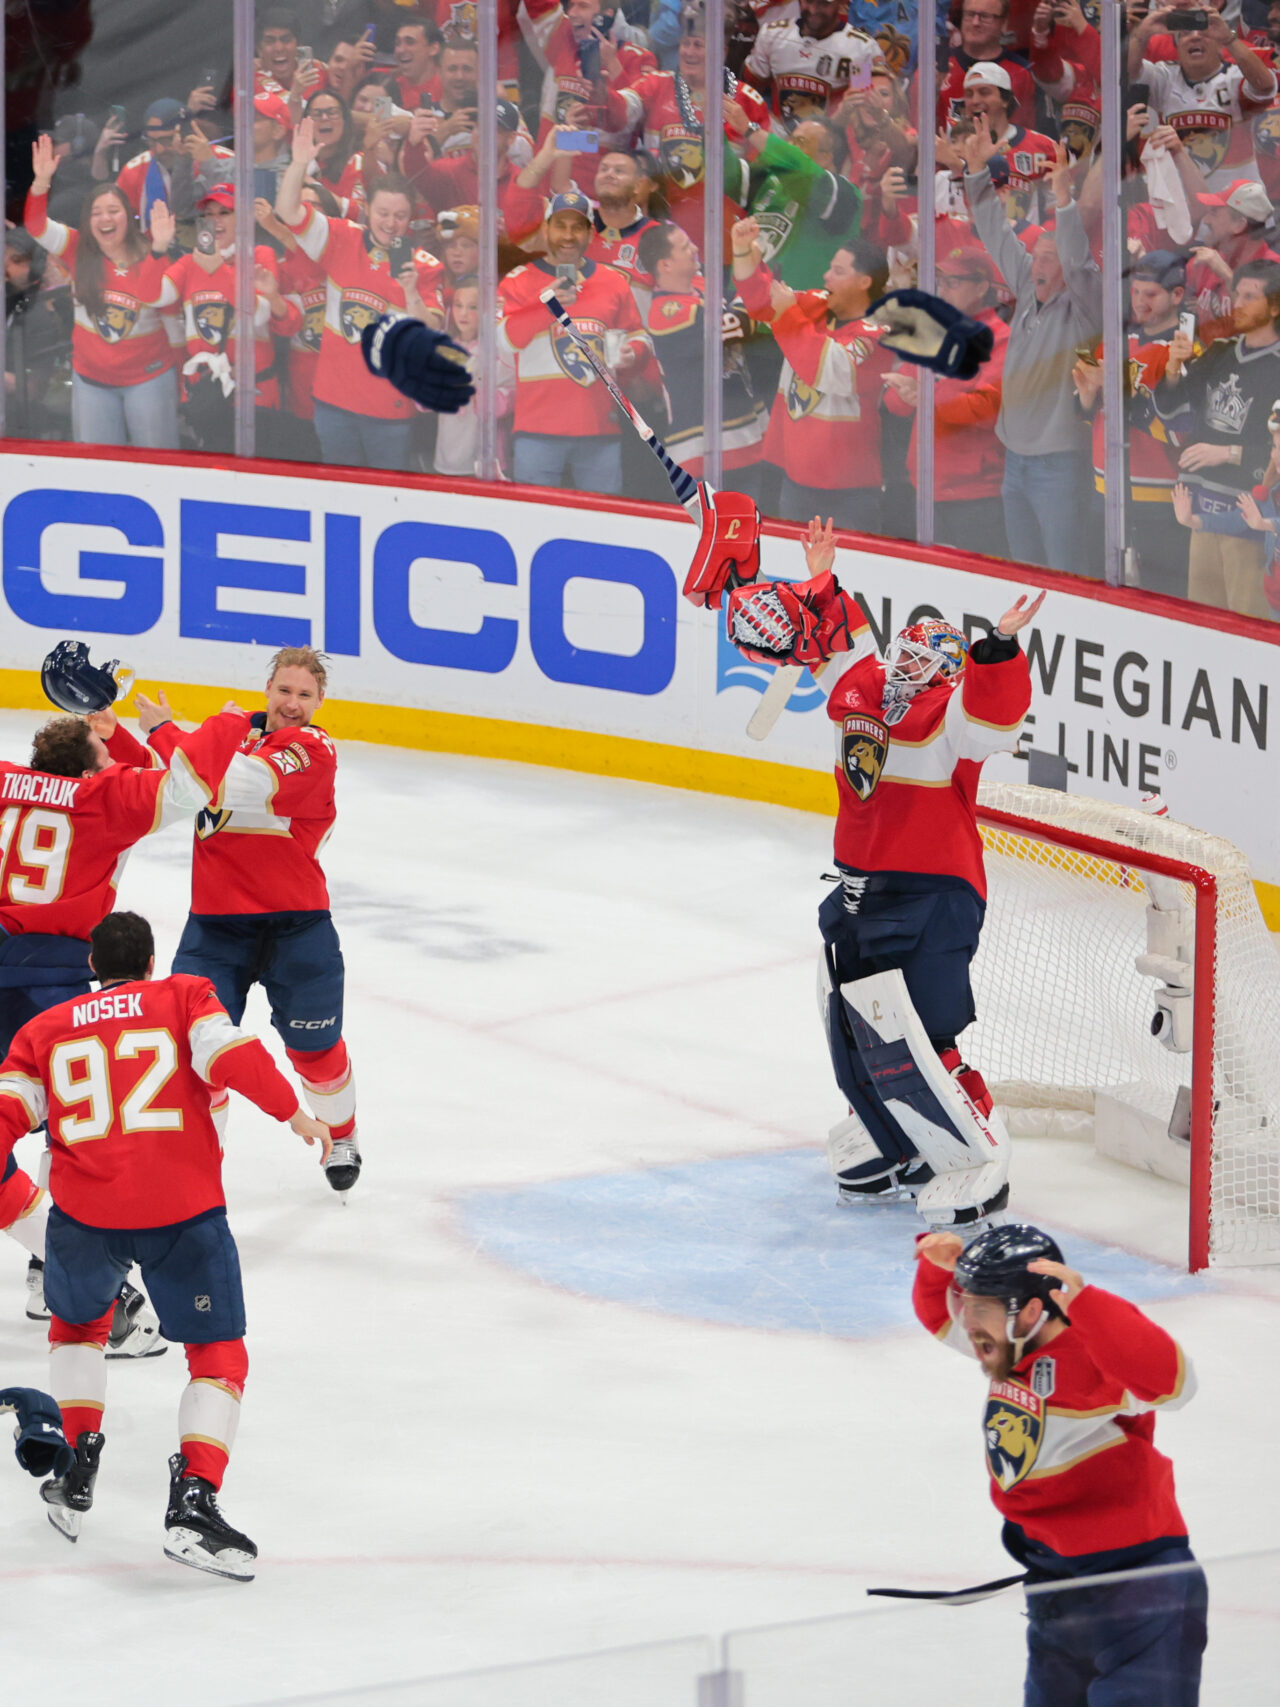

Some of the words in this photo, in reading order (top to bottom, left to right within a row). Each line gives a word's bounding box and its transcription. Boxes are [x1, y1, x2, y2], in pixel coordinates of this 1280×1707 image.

[1172, 114, 1226, 128] FLORIDA
[344, 290, 386, 311] PANTHERS
[556, 322, 604, 335] PTHERS
[2, 488, 678, 696] GEICO
[846, 719, 885, 741] PANTHERS
[1, 772, 81, 809] TKACHUK
[72, 993, 144, 1029] NOSEK
[289, 1016, 337, 1031] CCM
[872, 1062, 913, 1079] TRUE
[48, 1026, 184, 1146] 92
[954, 1082, 999, 1147] TRUE
